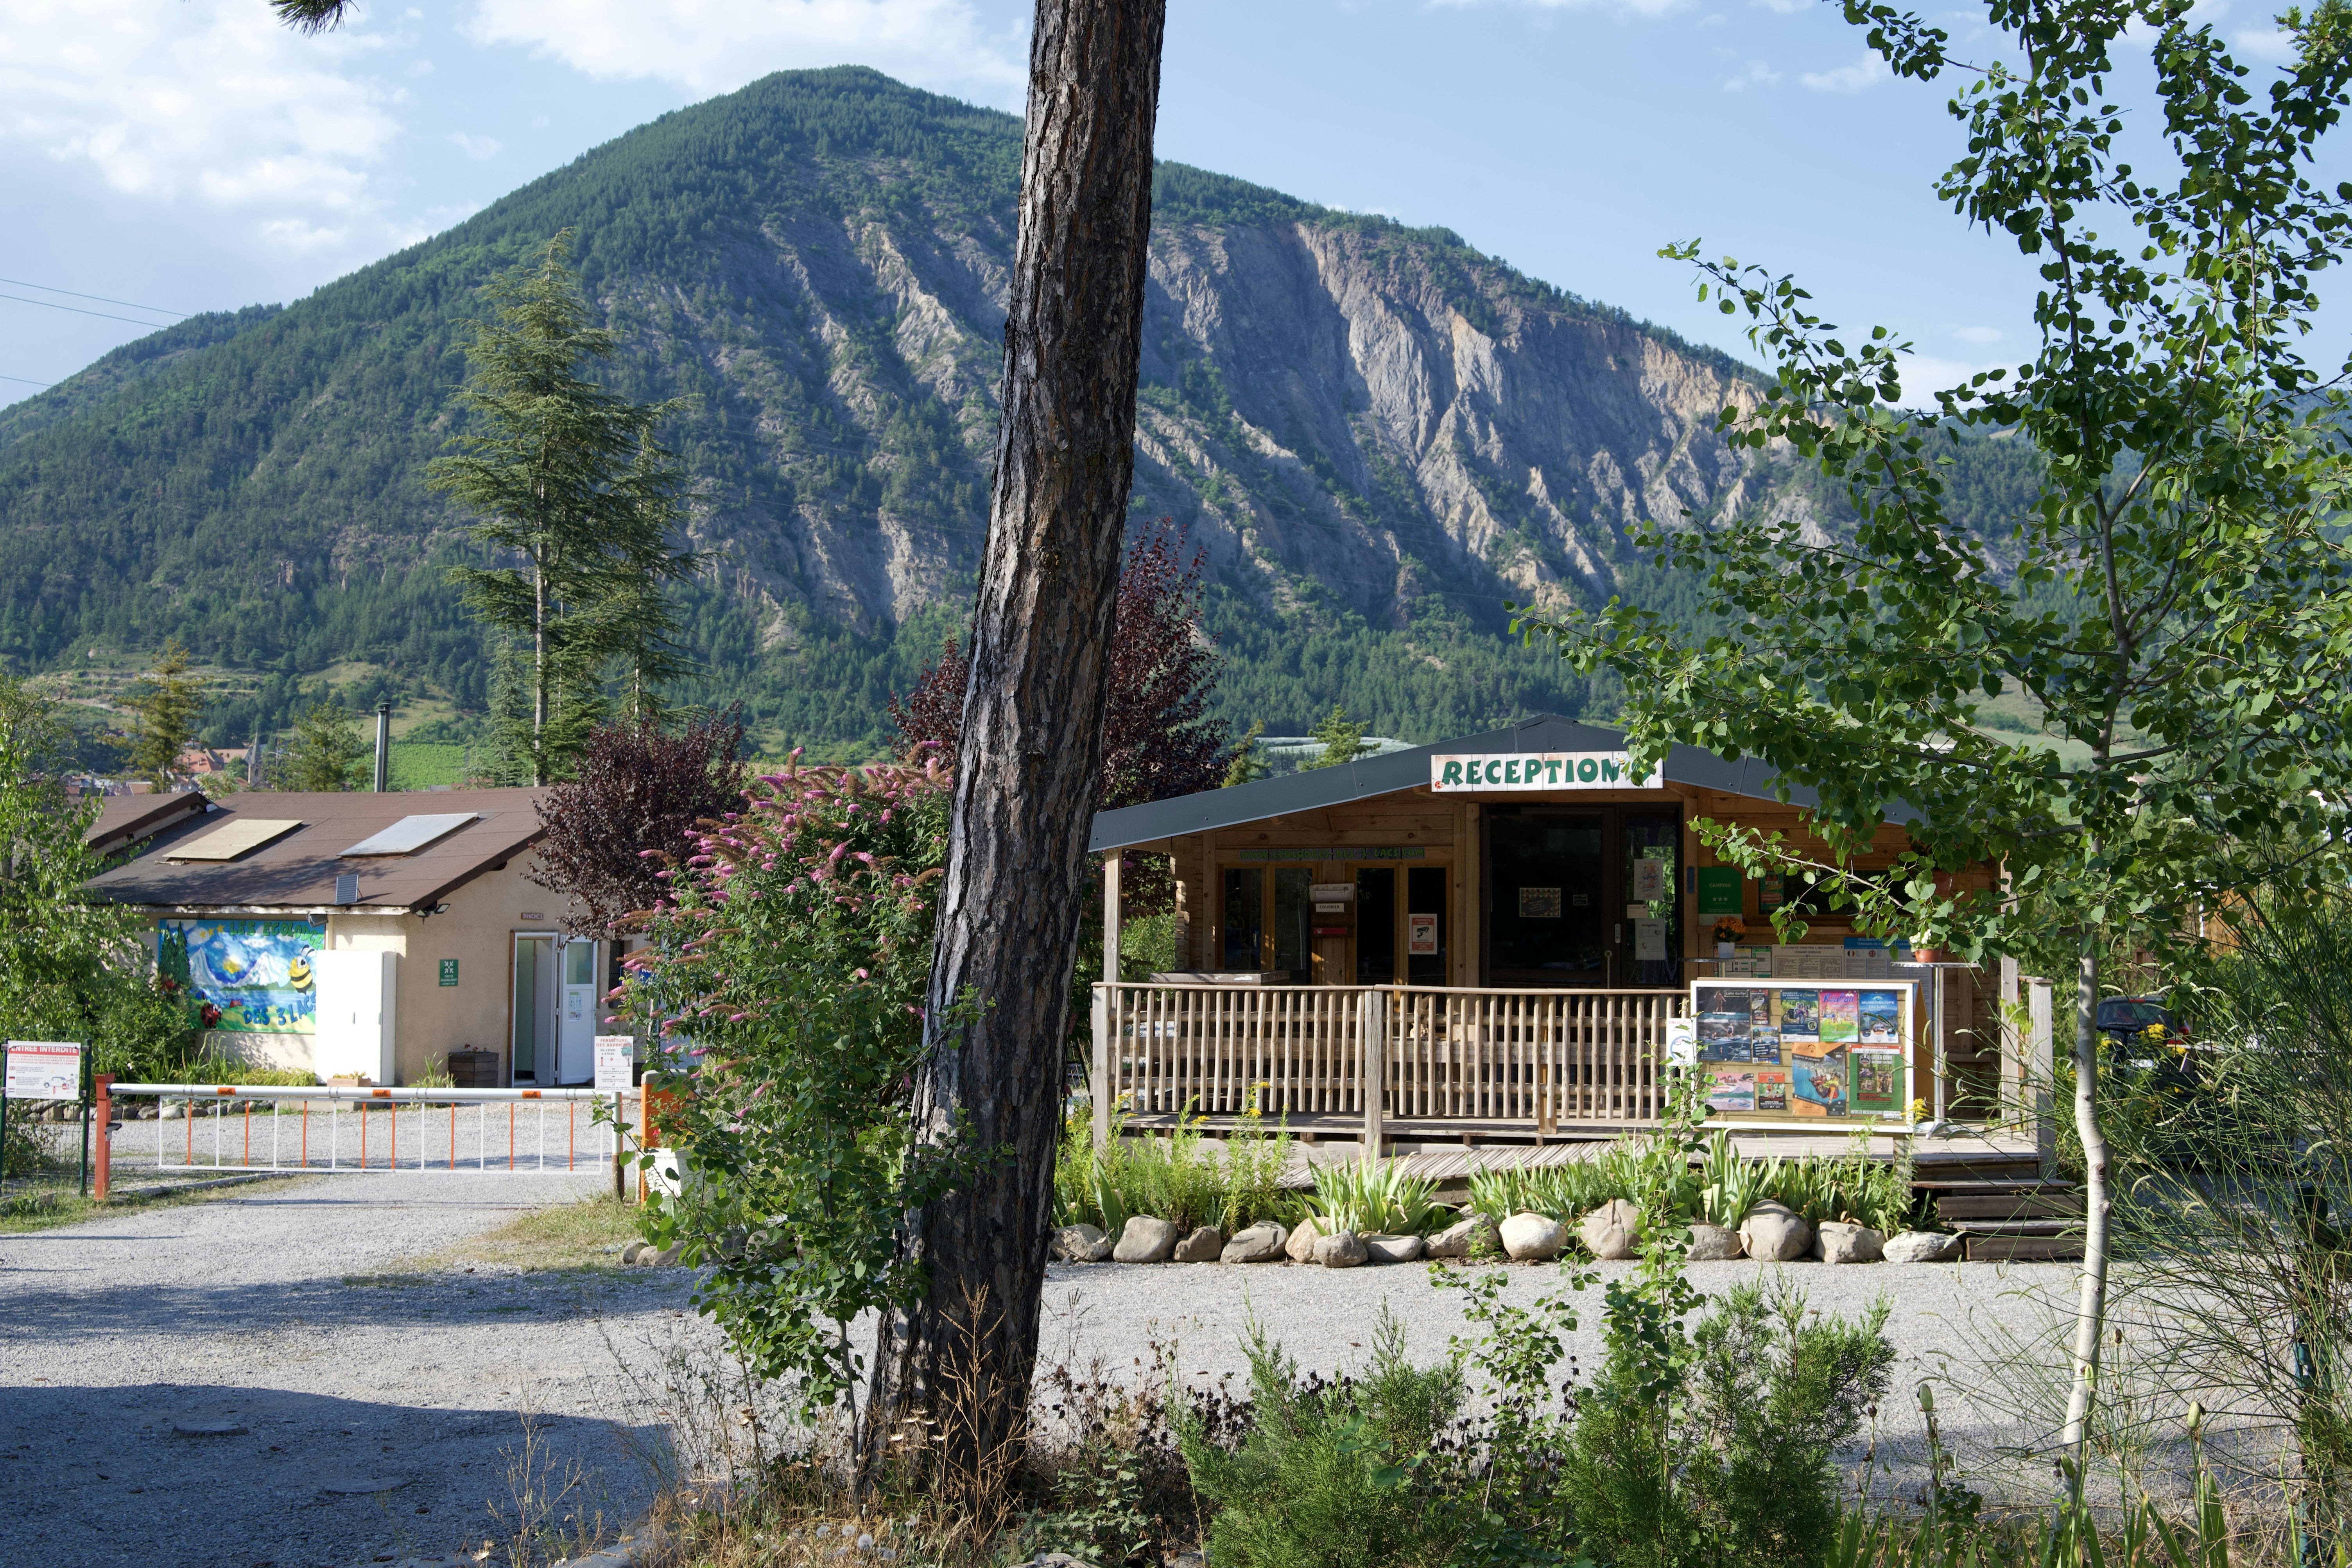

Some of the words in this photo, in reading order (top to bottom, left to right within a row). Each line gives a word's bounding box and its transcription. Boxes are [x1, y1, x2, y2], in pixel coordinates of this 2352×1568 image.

[1443, 758, 1619, 786] RECEPTION
[229, 921, 256, 936] LES
[1823, 993, 1854, 1003] Réallon
[243, 1008, 270, 1025] DES
[276, 1007, 286, 1025] 3
